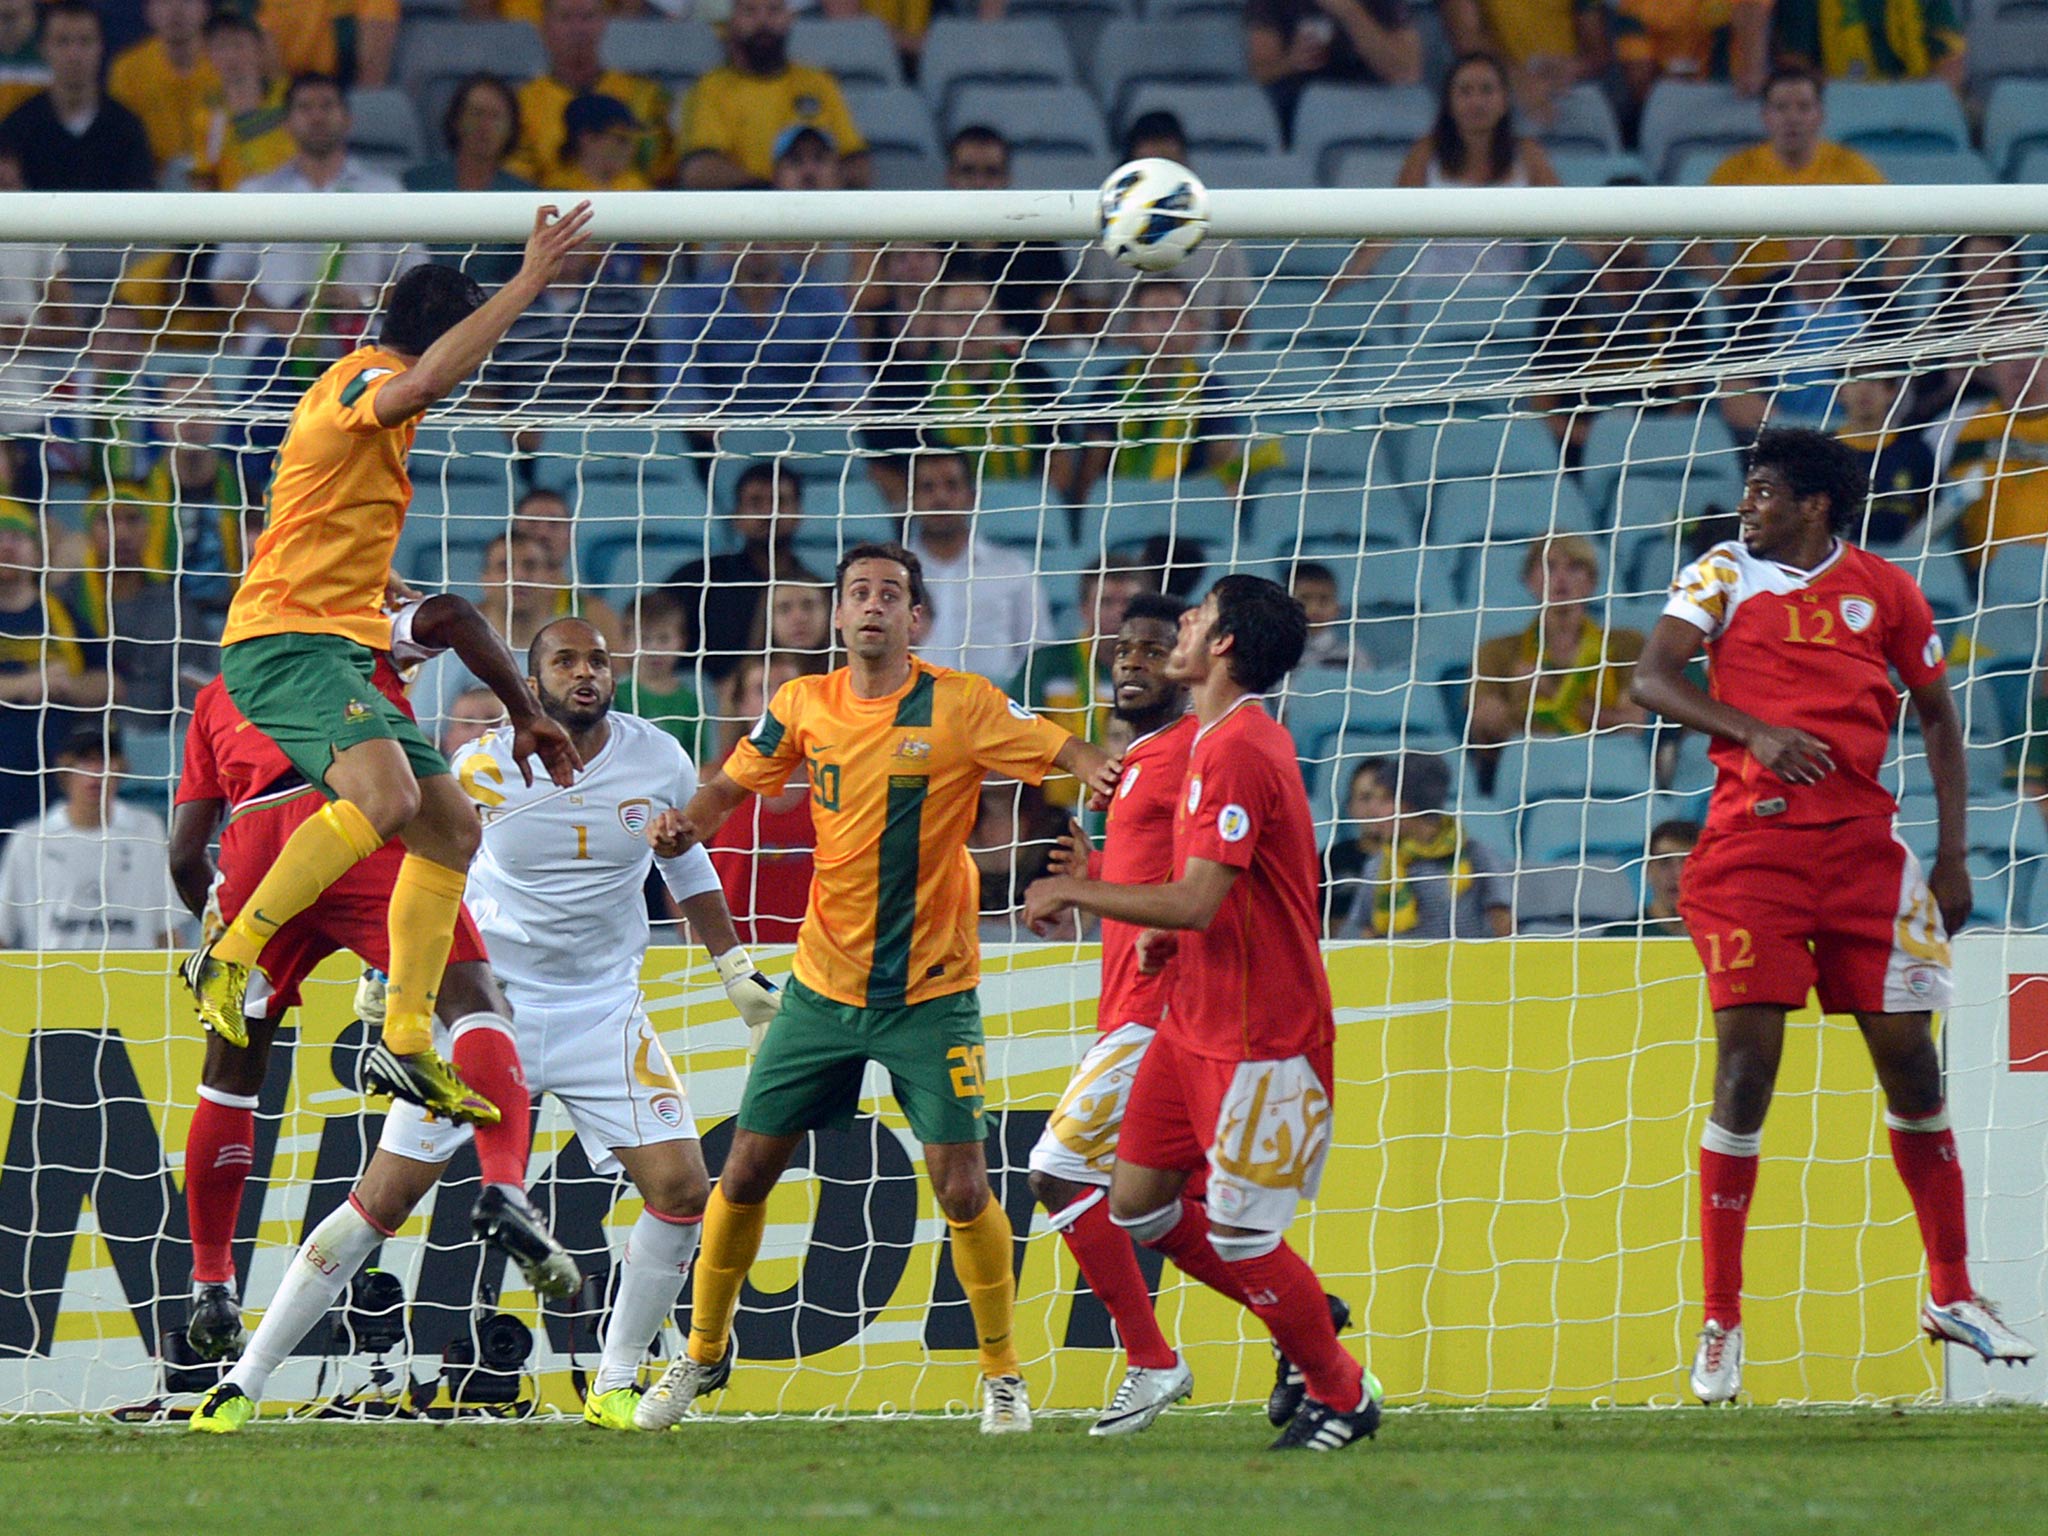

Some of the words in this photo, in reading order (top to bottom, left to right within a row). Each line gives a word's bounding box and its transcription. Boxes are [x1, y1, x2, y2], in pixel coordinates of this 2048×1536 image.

[1783, 604, 1836, 645] 12
[571, 825, 593, 860] 1
[1705, 928, 1756, 974] 12
[946, 1045, 985, 1097] 20
